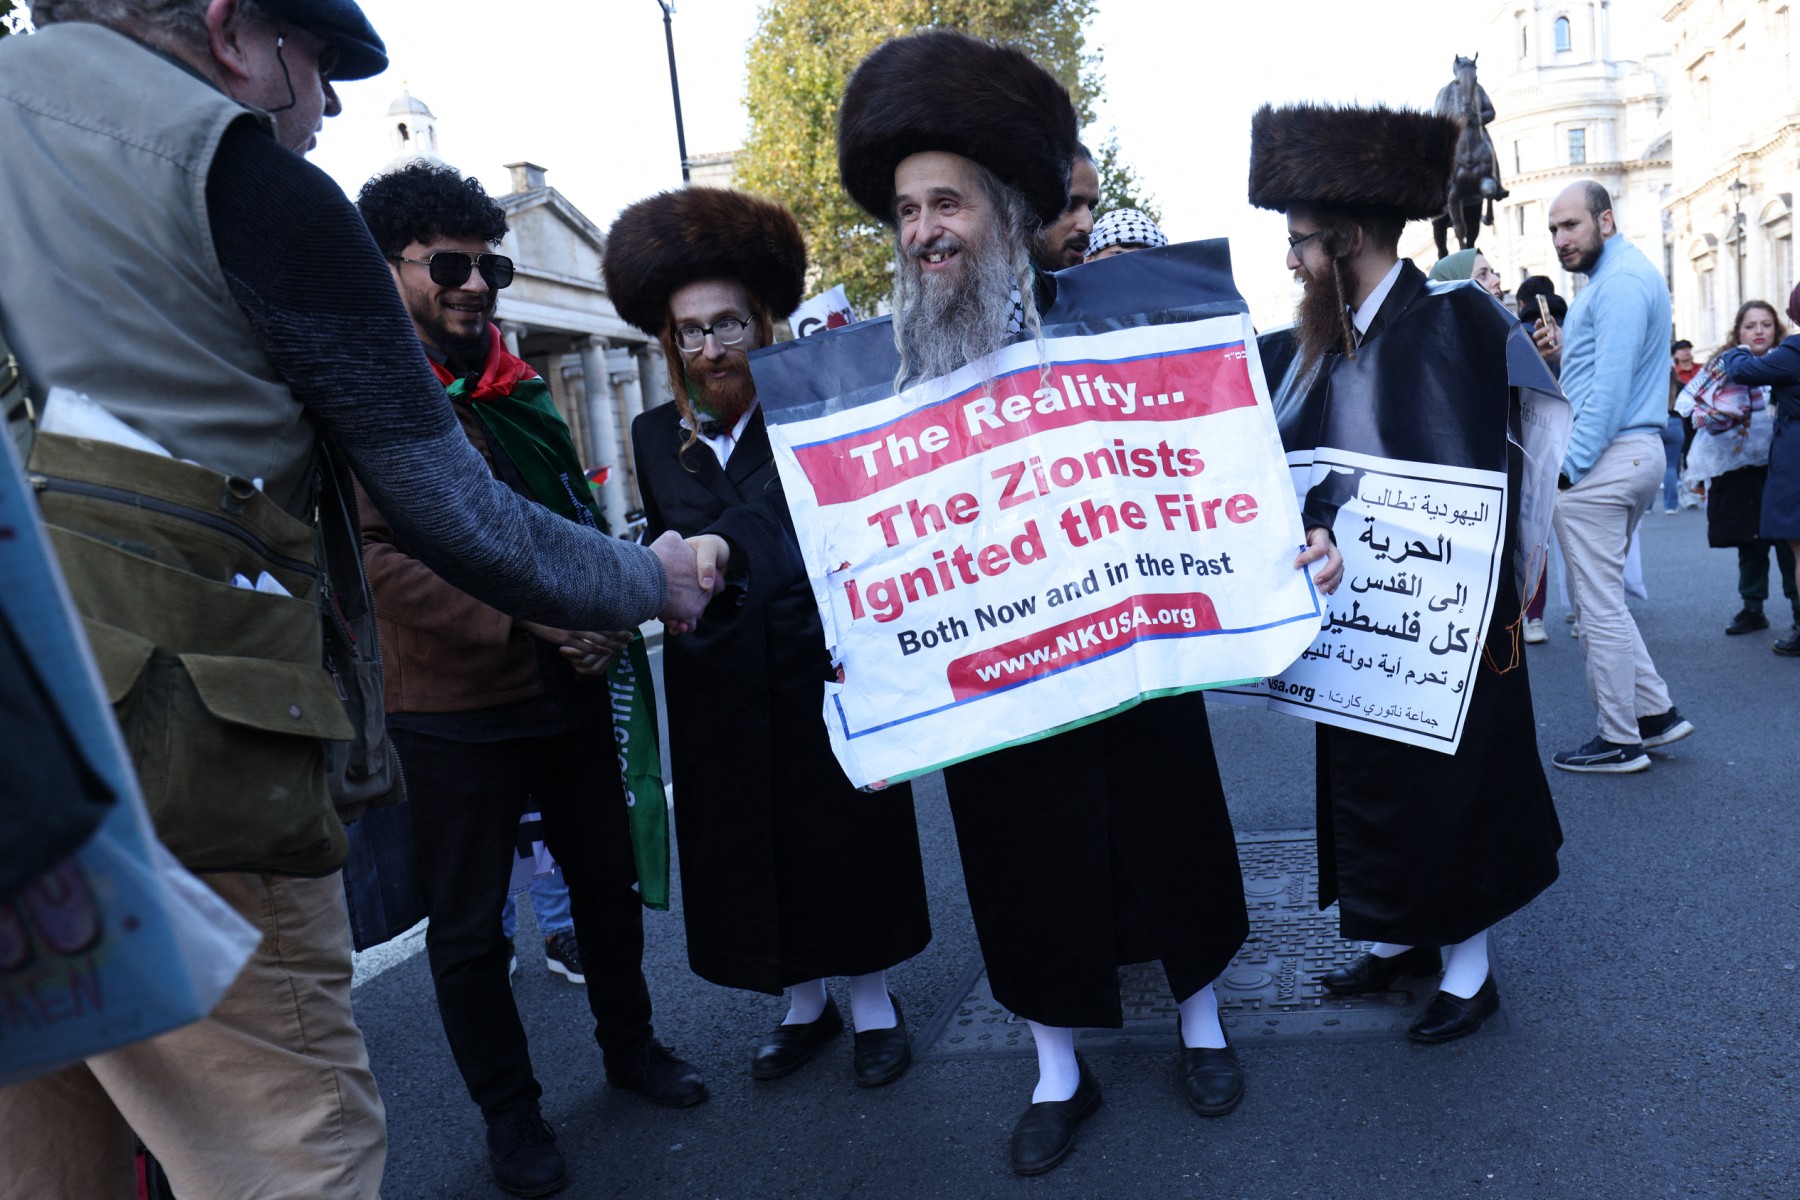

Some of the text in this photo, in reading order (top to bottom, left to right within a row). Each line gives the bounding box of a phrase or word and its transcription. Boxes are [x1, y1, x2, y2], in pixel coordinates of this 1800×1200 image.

[849, 374, 1185, 478] The Reality...
[867, 439, 1205, 548] The Zionists
[1361, 488, 1417, 512] تطالب
[1421, 494, 1488, 527] اليهودية
[844, 493, 1259, 623] Ignited the Fire
[1359, 516, 1452, 564] الحرية
[897, 552, 1234, 656] Both Now and in the Past
[1350, 571, 1467, 613] إلى القدس
[975, 606, 1196, 682] www.NKUSA.org
[1336, 644, 1372, 671] دولة
[1429, 621, 1470, 655] كل
[1405, 670, 1448, 685] تحرم
[1275, 957, 1296, 1000] vodafone
